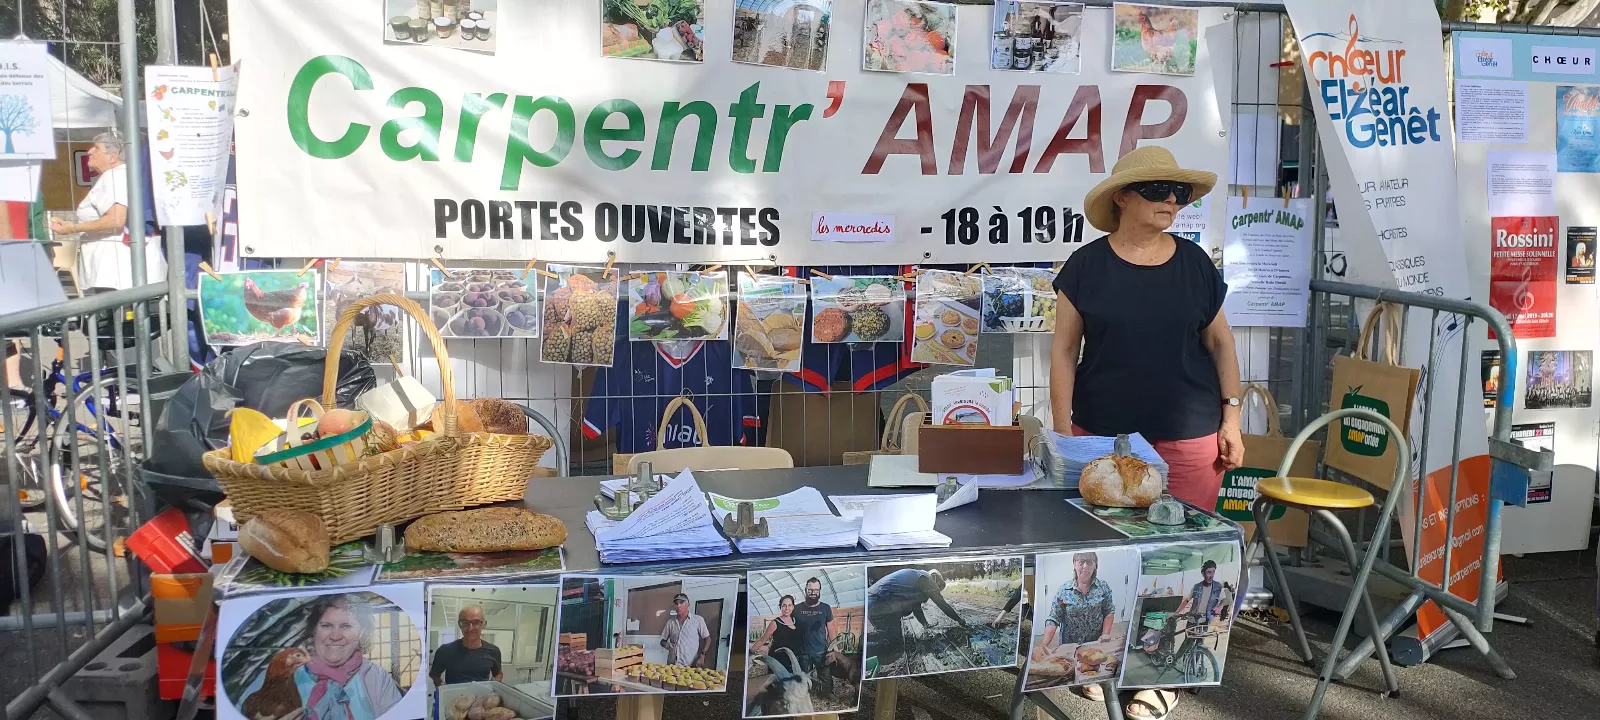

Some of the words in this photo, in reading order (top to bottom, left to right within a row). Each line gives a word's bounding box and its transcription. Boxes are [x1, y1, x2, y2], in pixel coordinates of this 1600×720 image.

[287, 55, 846, 191] Carpentr'
[860, 83, 1189, 176] AMAP
[1346, 106, 1440, 148] Genêt
[433, 198, 583, 241] PORTES
[594, 201, 781, 247] OUVERTES
[816, 219, 831, 234] les
[941, 207, 979, 245] 18
[988, 205, 1009, 244] à
[1017, 204, 1056, 244] 19
[1062, 206, 1085, 243] h
[1275, 210, 1304, 230] AMAP
[1496, 228, 1553, 248] Rossini
[1231, 475, 1263, 487] L'AMA
[1227, 487, 1261, 499] engage
